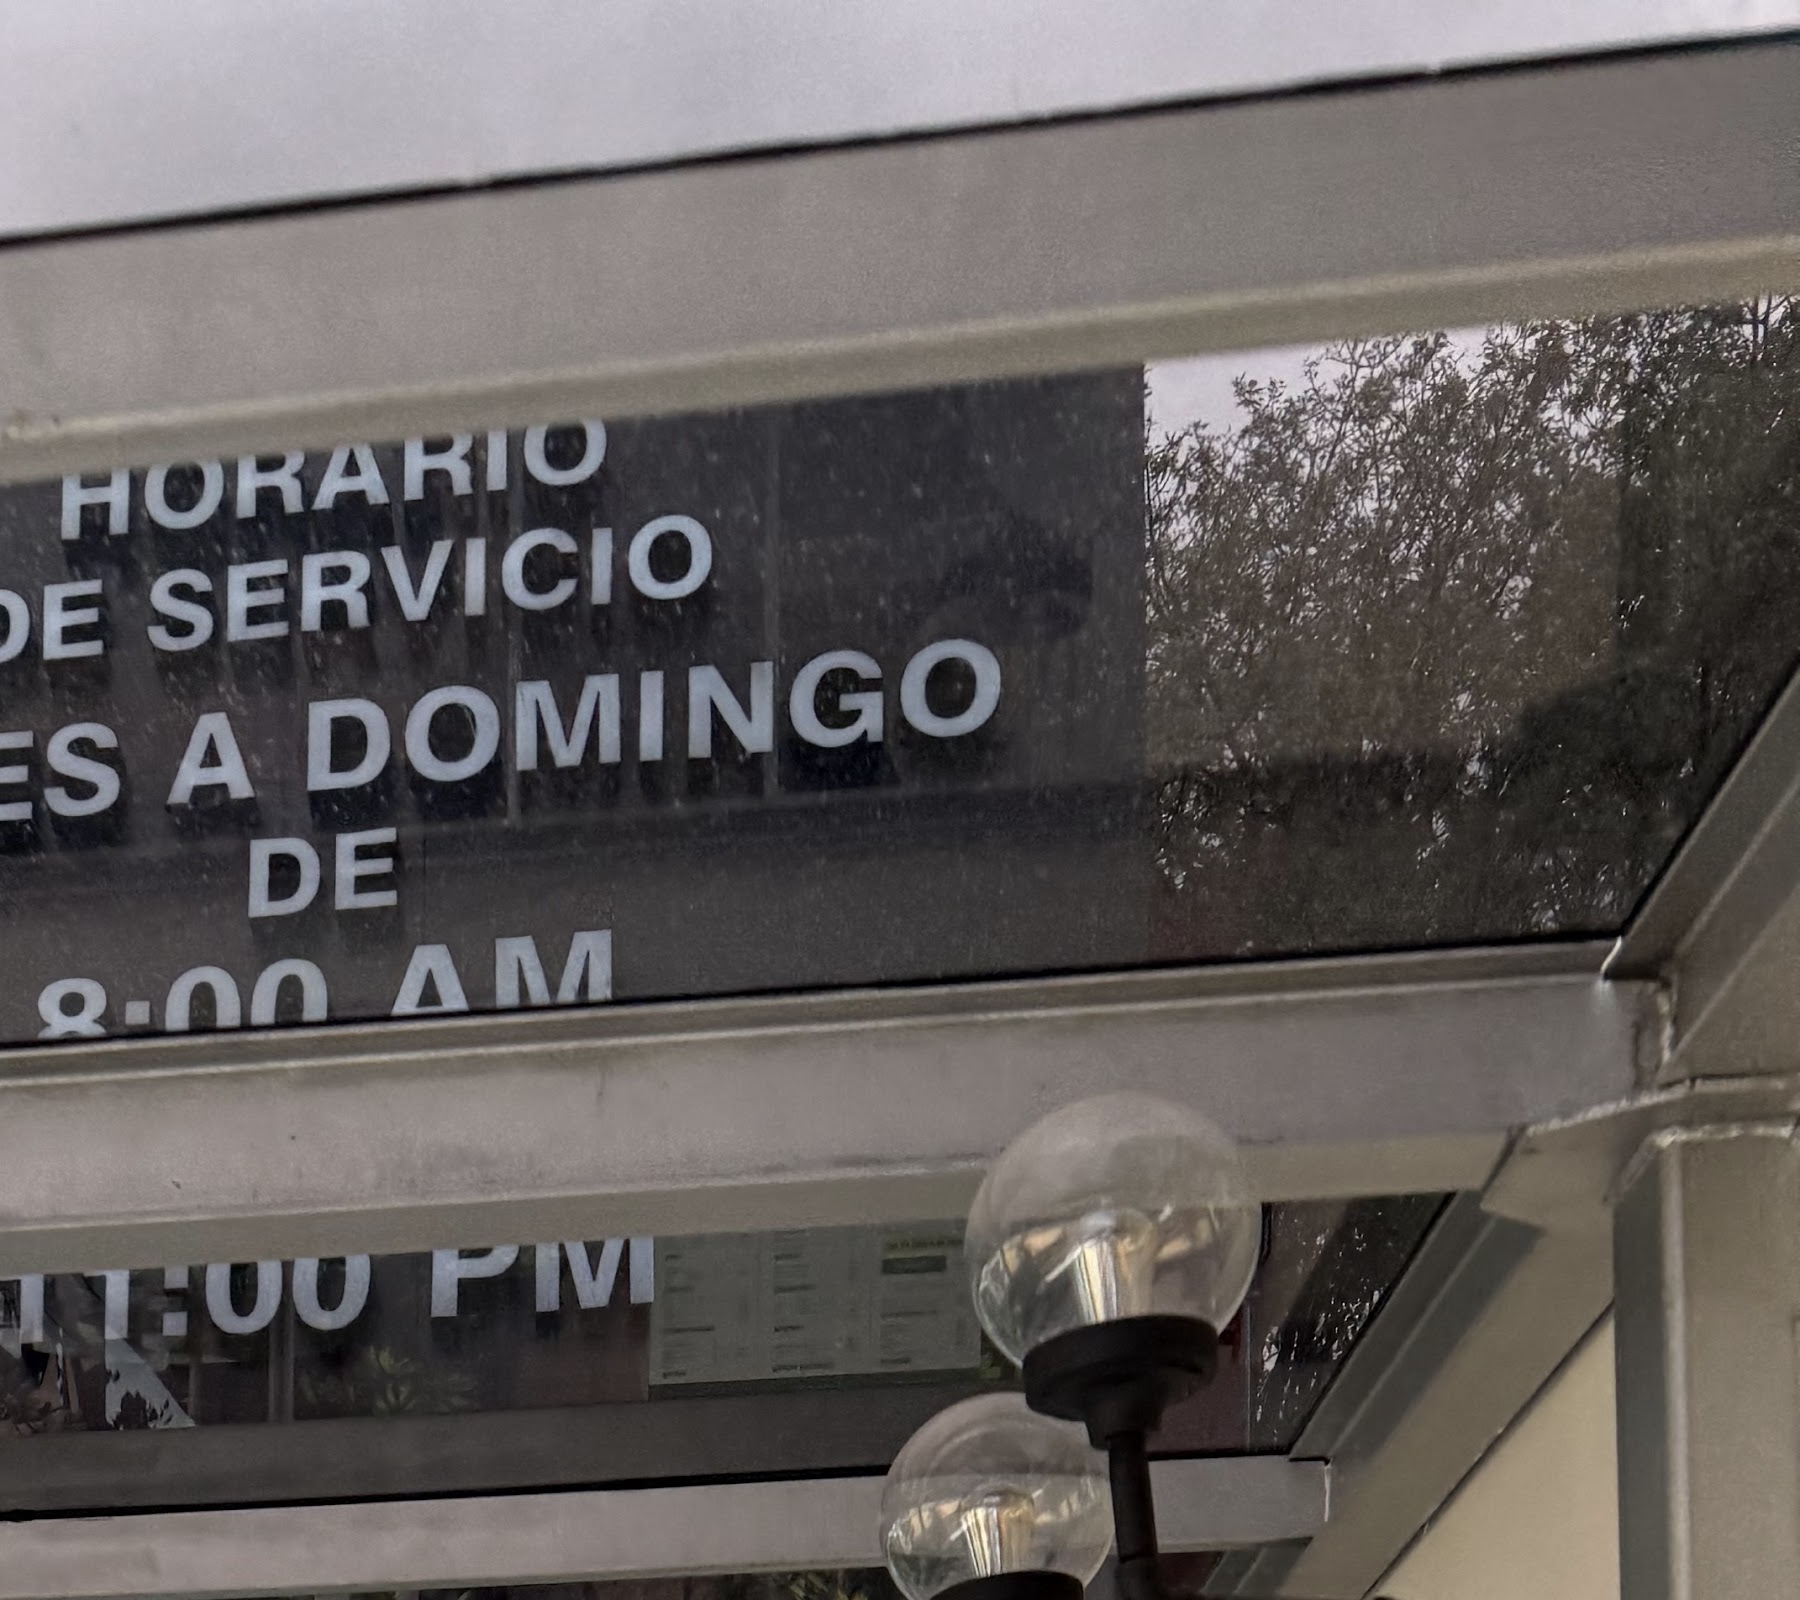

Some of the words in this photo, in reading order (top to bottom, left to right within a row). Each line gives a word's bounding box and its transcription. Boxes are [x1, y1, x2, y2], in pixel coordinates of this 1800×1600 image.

[60, 421, 607, 540] HORARIO
[147, 514, 715, 652] SERVICIO
[167, 711, 255, 806] A
[306, 638, 1003, 793] DOMINGO
[247, 827, 398, 920] DE
[390, 928, 614, 1017] AM
[430, 1235, 655, 1319] PM
